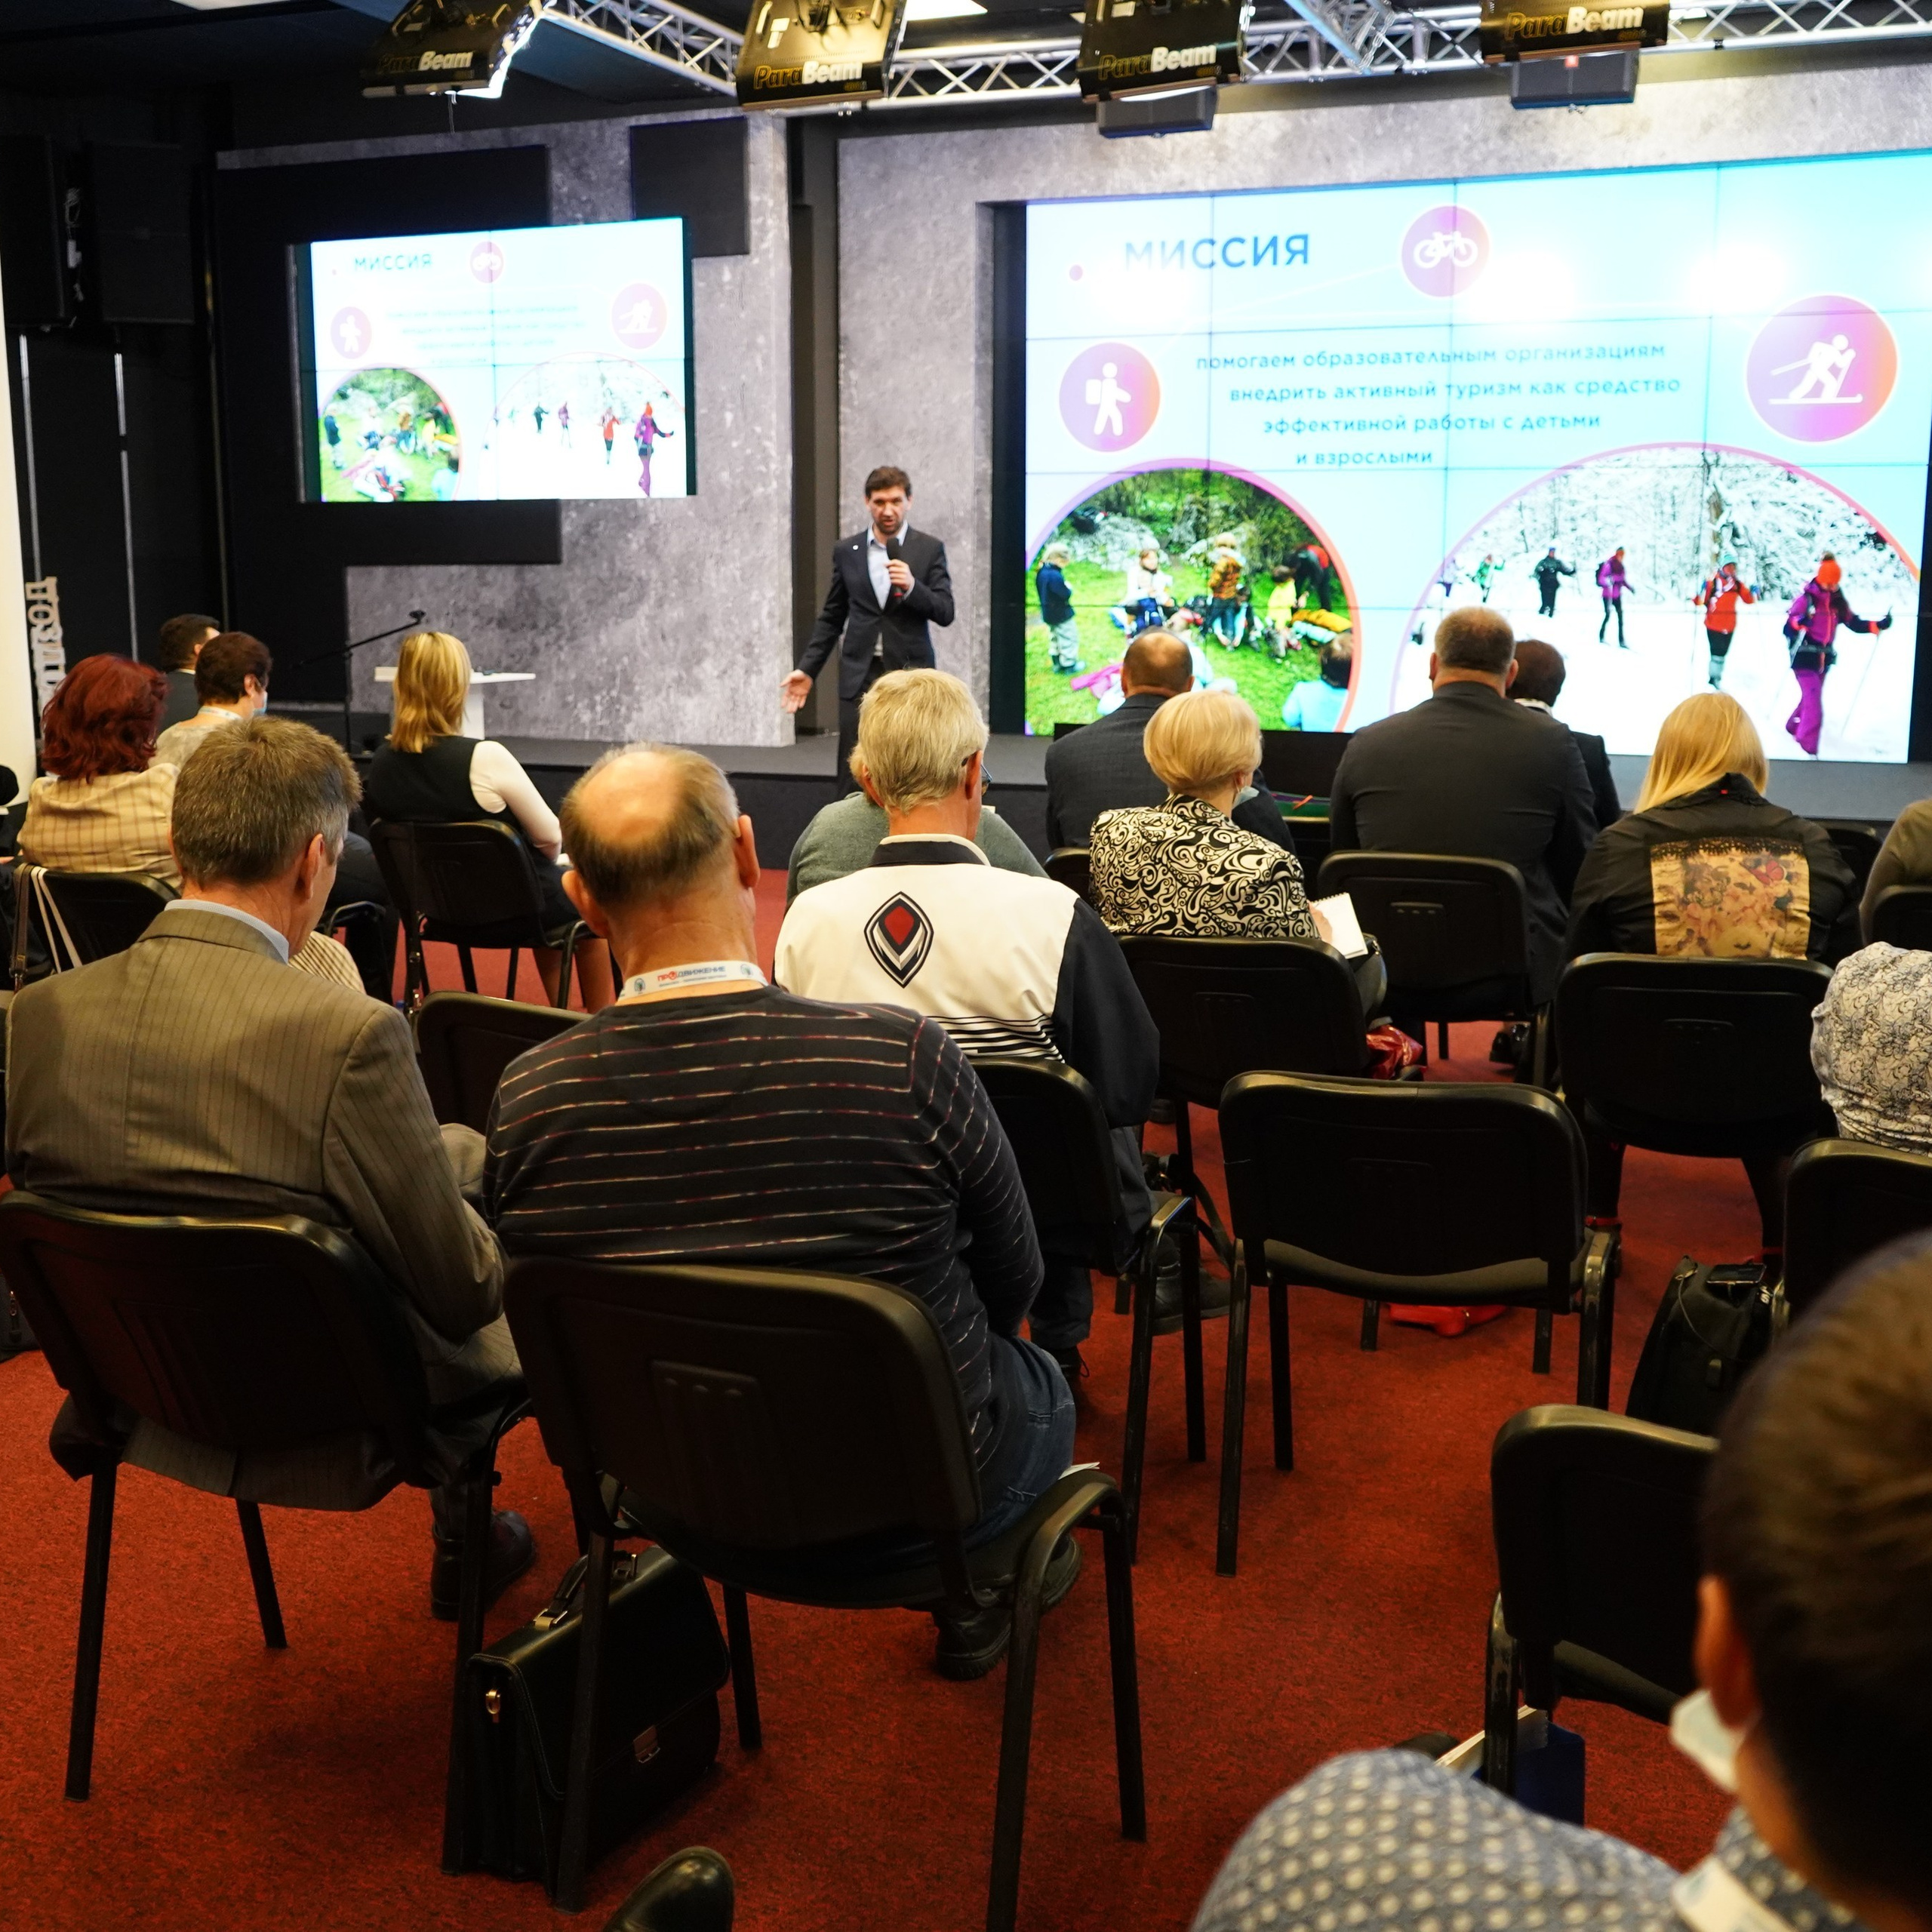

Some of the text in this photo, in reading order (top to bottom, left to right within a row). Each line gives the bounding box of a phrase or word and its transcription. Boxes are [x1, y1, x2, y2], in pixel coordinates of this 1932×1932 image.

[1505, 6, 1644, 41] ParaBeam
[754, 60, 863, 90] ParaBeam
[1098, 44, 1217, 81] ParaBeam
[353, 252, 435, 272] МИССИЯ
[1124, 233, 1311, 272] МИССИЯ
[1196, 345, 1666, 370] помогаем образовательным организациям
[1229, 378, 1681, 403] внедрить активный туризм как средство
[1263, 414, 1601, 435] эффективной работы с детьми
[1296, 452, 1432, 467] и взрослыми
